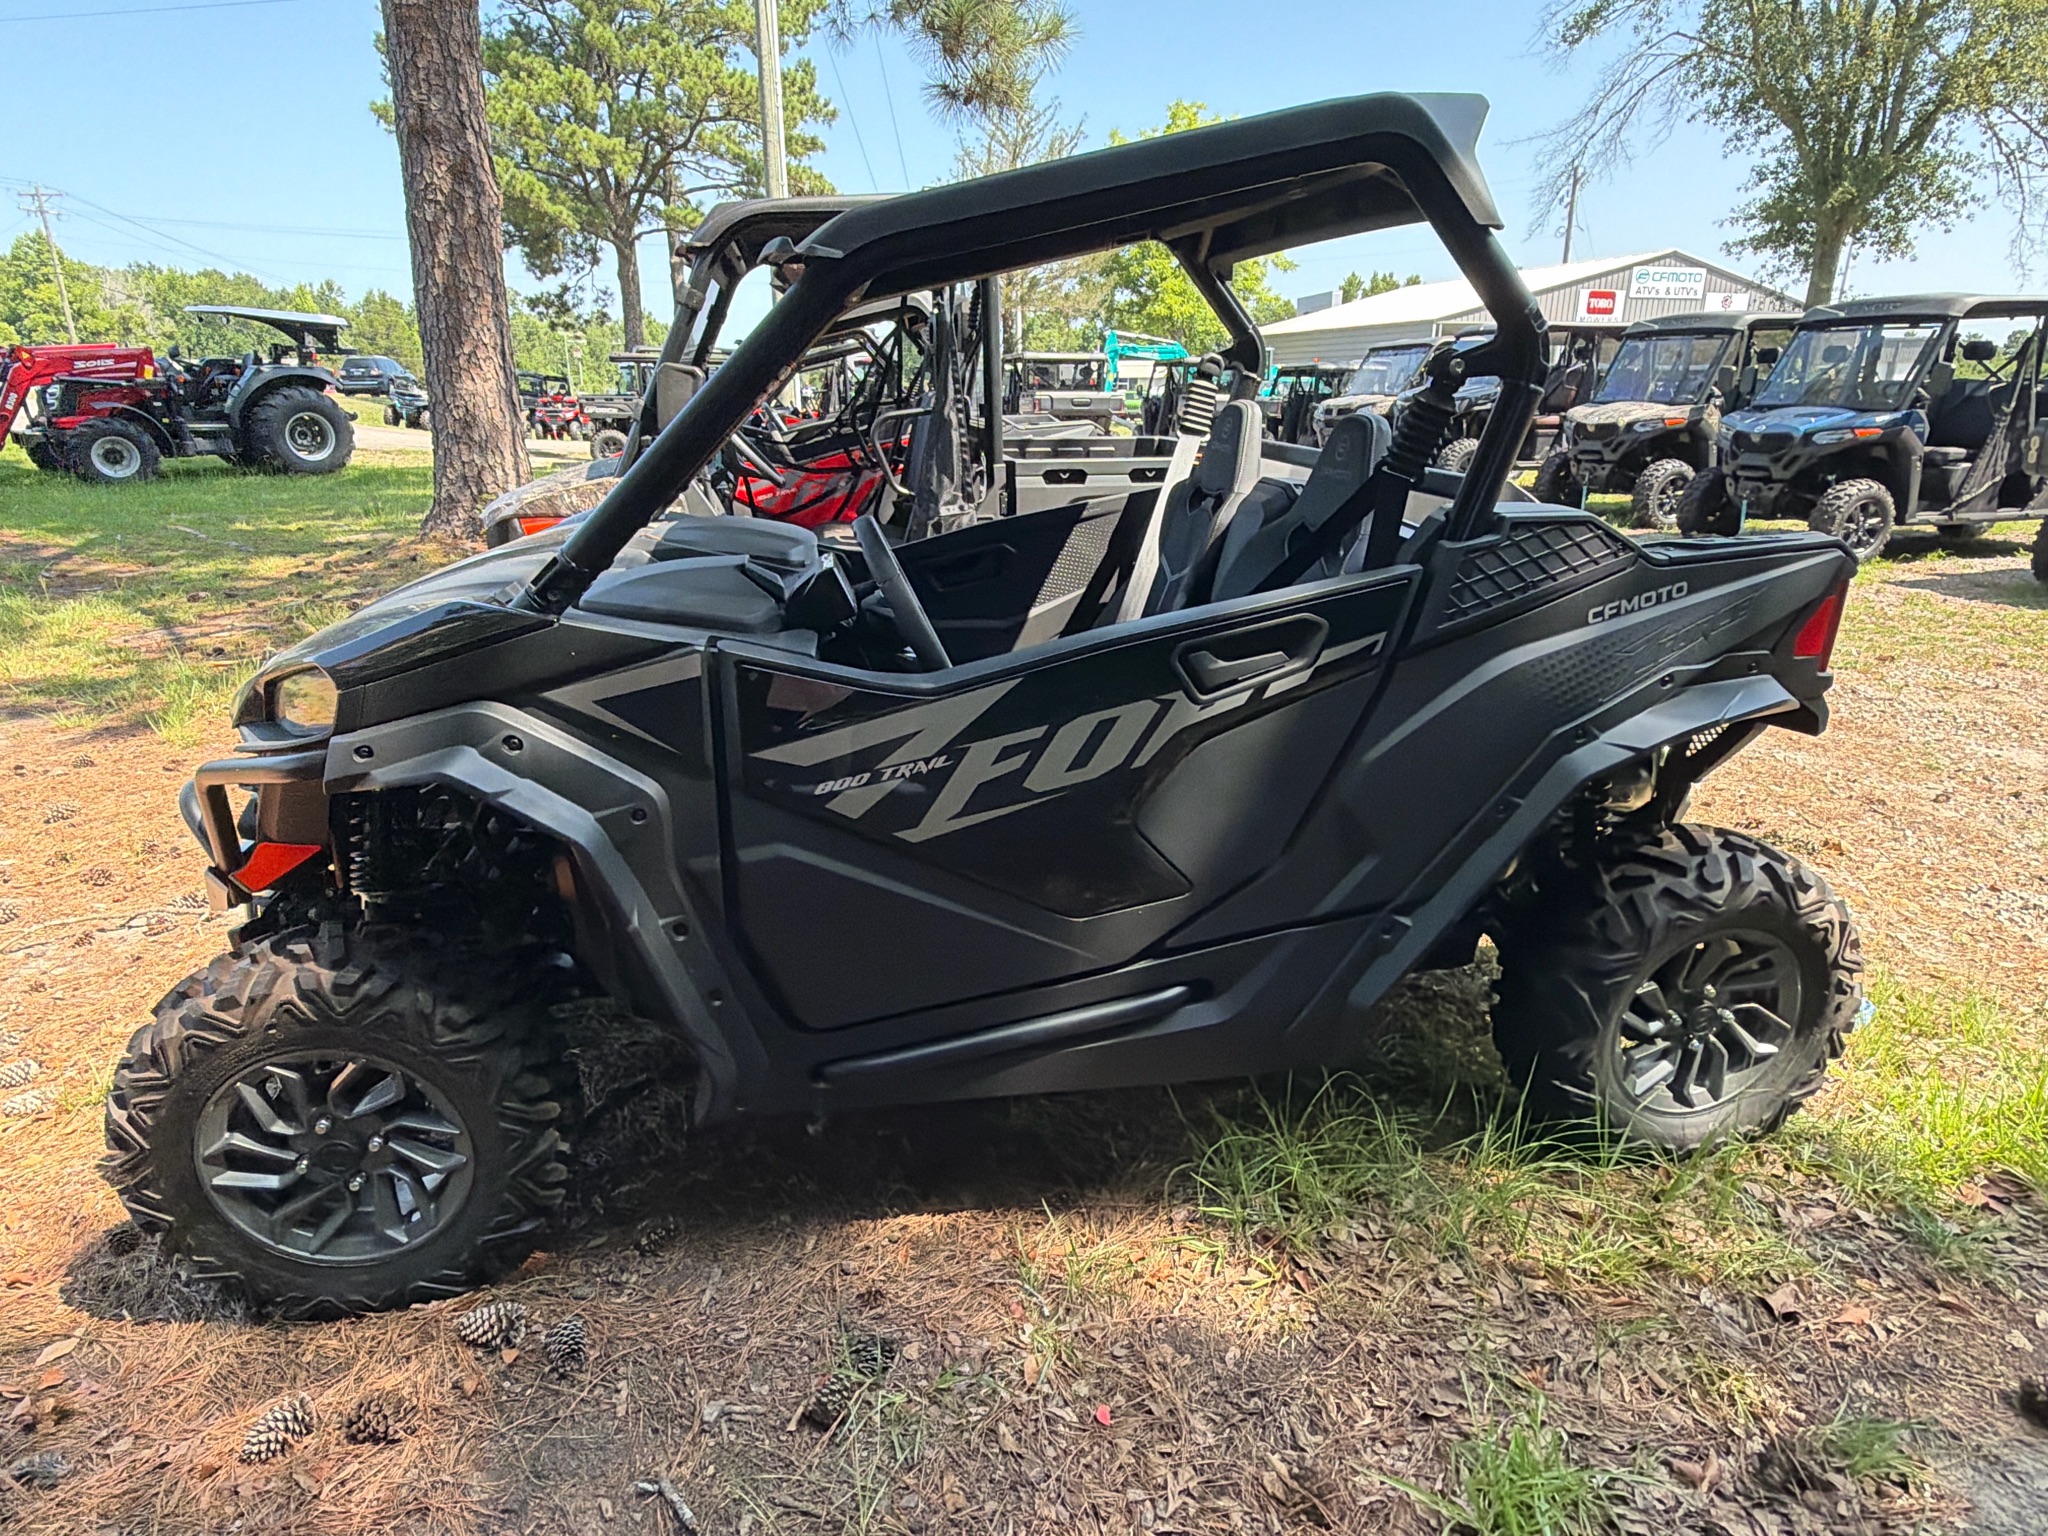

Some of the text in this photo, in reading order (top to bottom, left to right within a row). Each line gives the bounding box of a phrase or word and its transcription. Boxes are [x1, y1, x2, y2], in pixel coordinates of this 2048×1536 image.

[1652, 271, 1703, 283] CFMOTO
[1635, 286, 1698, 297] ATV's & UTV's
[1589, 298, 1614, 309] TORO
[1587, 581, 1689, 625] CFMOTO
[814, 755, 954, 796] 800 TRAIL
